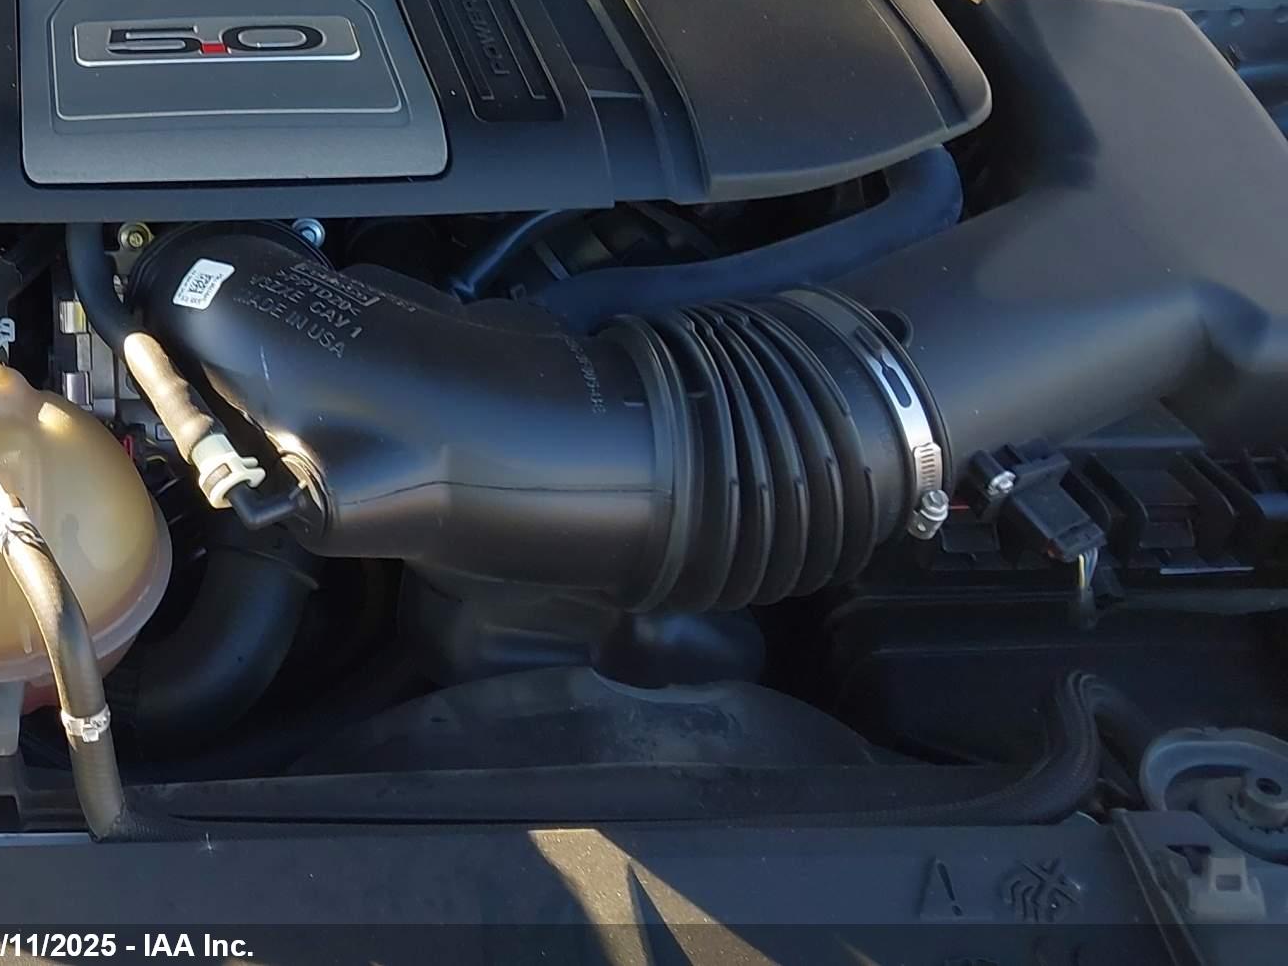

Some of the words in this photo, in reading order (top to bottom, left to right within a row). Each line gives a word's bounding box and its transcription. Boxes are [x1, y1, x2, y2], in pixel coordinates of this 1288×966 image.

[106, 24, 327, 55] 5.0
[309, 300, 352, 328] CAV
[285, 311, 309, 330] IN
[307, 323, 346, 359] USA
